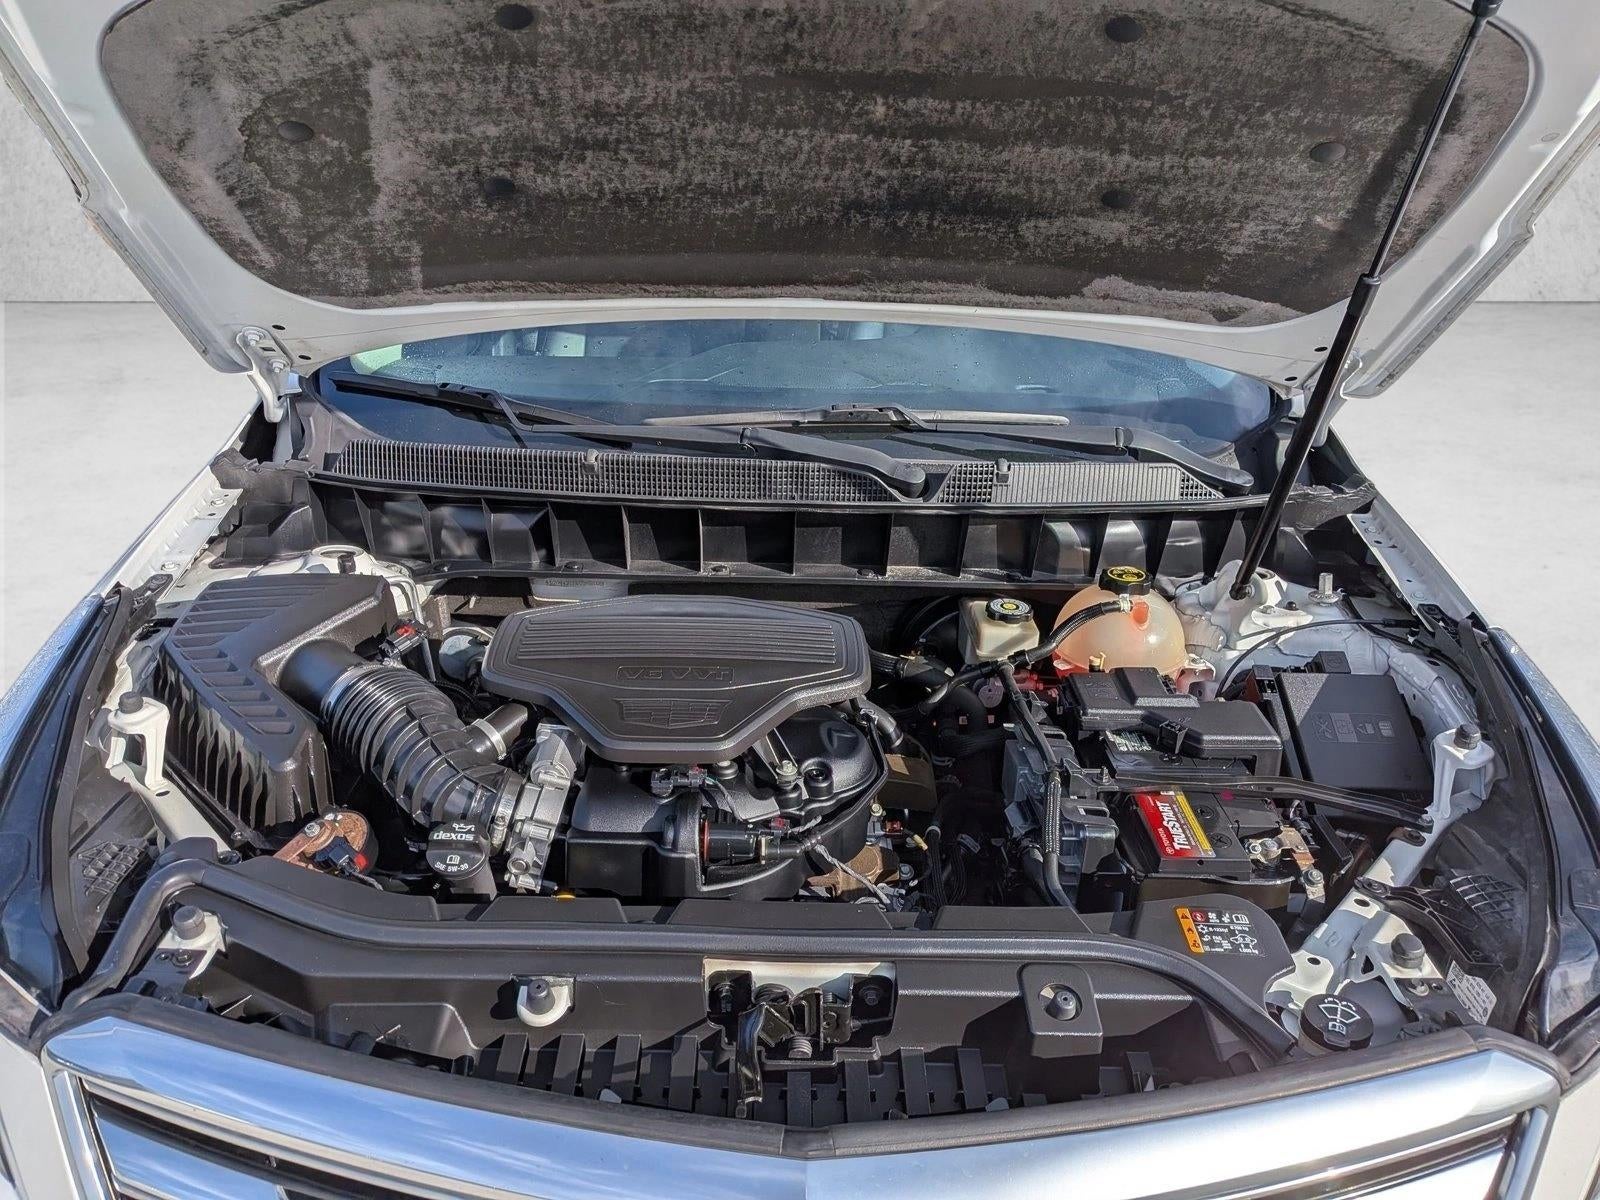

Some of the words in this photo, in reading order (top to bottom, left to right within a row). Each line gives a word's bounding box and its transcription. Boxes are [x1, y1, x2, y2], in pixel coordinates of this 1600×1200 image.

[433, 831, 475, 841] dexos
[1157, 827, 1170, 847] TOYOTA
[434, 861, 447, 871] SAE
[447, 862, 469, 872] 5W-30
